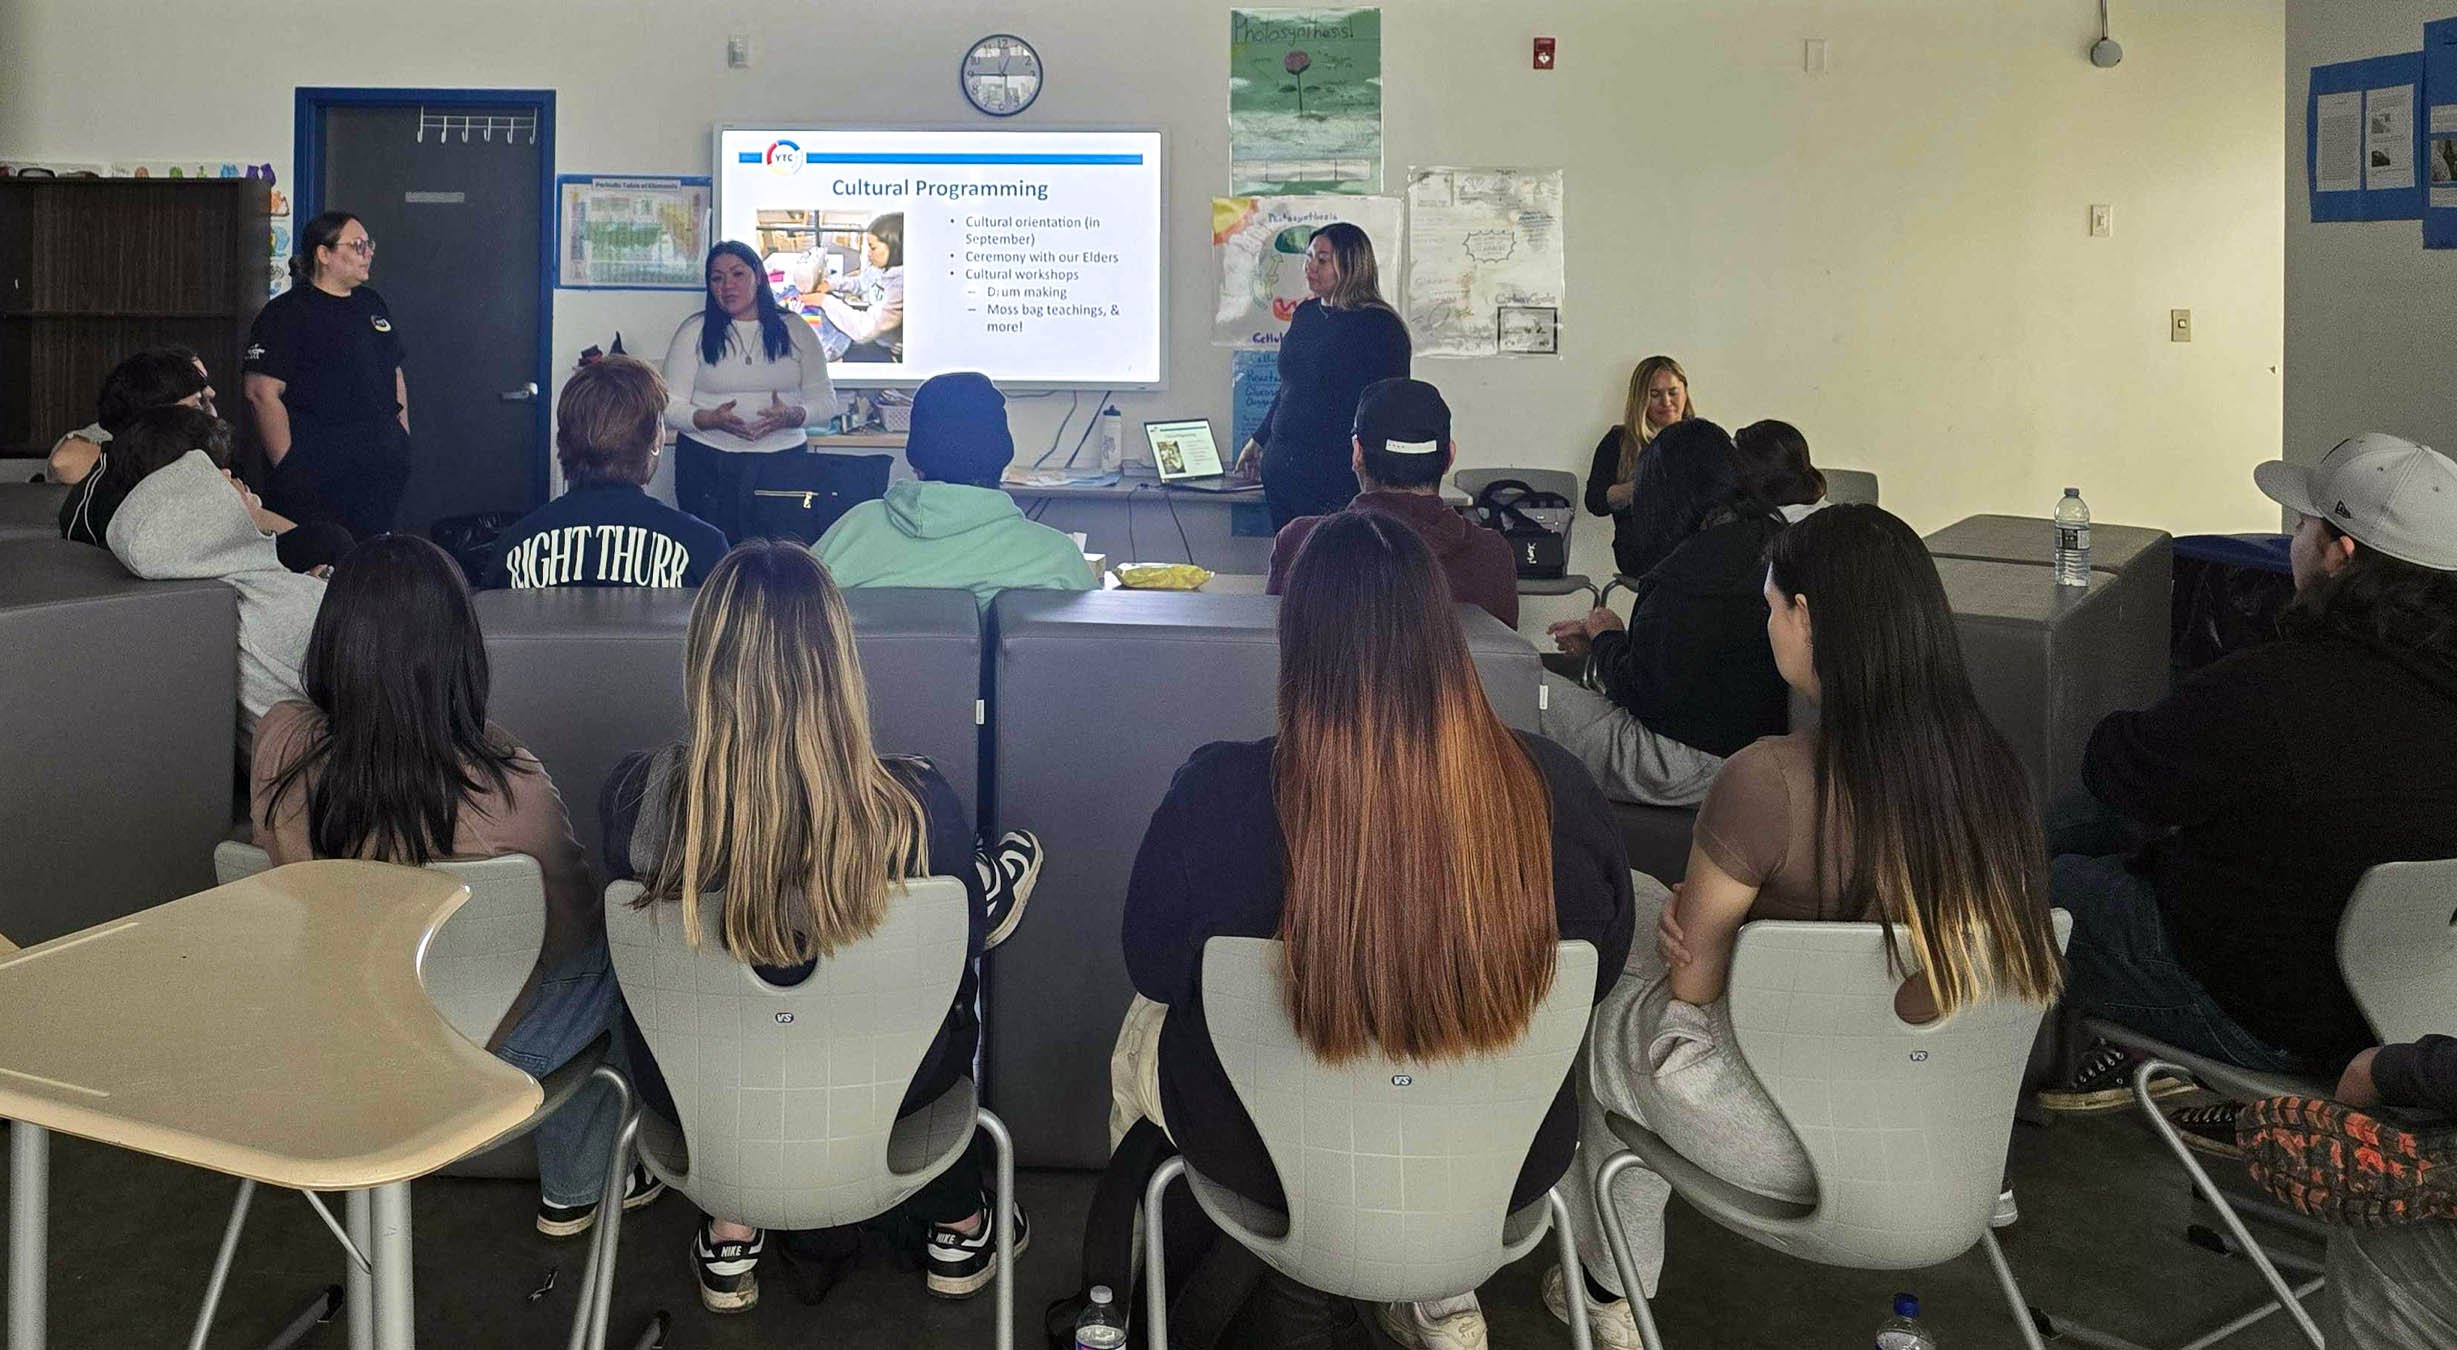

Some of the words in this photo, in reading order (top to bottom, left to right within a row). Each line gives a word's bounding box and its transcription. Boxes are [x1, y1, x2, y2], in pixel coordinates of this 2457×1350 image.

[775, 153, 793, 162] YTC
[832, 178, 909, 196] Cultural
[916, 179, 1049, 201] Programming
[965, 215, 1012, 229] Cultural
[1015, 215, 1081, 229] orientation
[1084, 215, 1100, 230] (in
[965, 233, 1035, 247] September)
[965, 251, 1026, 265] Ceremony
[1029, 251, 1056, 263] with
[1058, 253, 1079, 263] our
[1082, 251, 1119, 264] Elders
[965, 268, 1012, 281] Cultural
[1015, 268, 1079, 283] workshops
[1024, 286, 1068, 300] making
[987, 303, 1019, 316] Moss
[1022, 303, 1044, 318] bag
[1047, 303, 1107, 318] teachings,
[1110, 303, 1120, 316] &
[987, 320, 1023, 333] more!
[506, 525, 592, 589] RIGHT
[595, 525, 690, 588] THURR
[776, 1013, 793, 1023] VS
[1912, 1051, 1927, 1061] VS
[1393, 1075, 1411, 1085] VS
[936, 1231, 956, 1245] NIKE
[720, 1245, 742, 1258] NIKE
